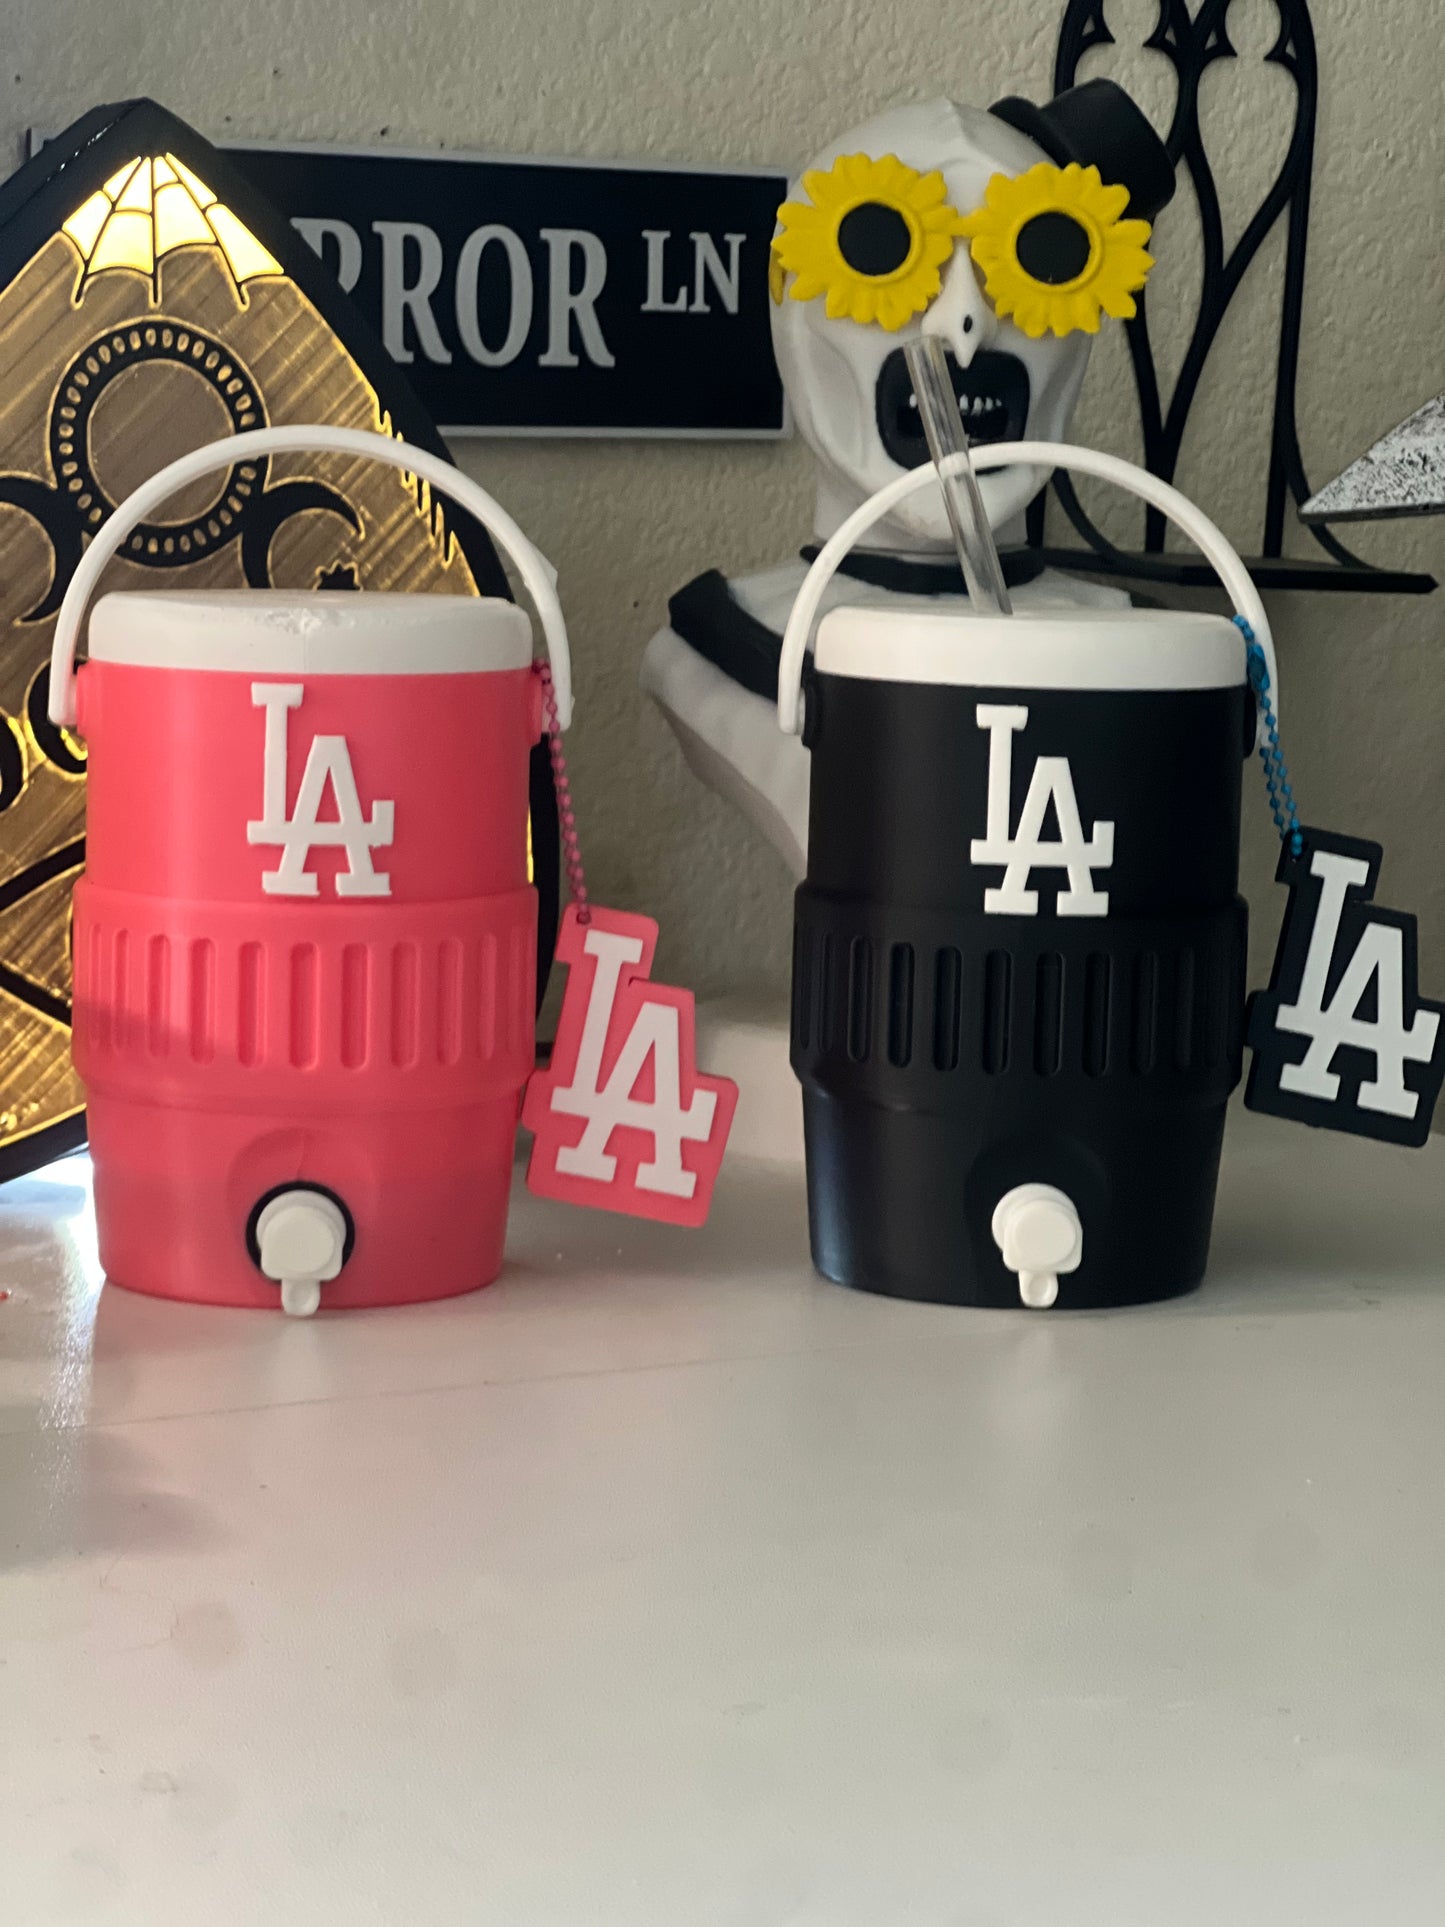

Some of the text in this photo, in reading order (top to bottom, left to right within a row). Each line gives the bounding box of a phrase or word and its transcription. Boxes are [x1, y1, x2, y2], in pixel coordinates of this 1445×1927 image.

[640, 229, 747, 315] LN
[246, 682, 395, 897] LA
[970, 704, 1115, 917] LA
[550, 929, 719, 1199] LA
[1275, 851, 1441, 1120] LA
